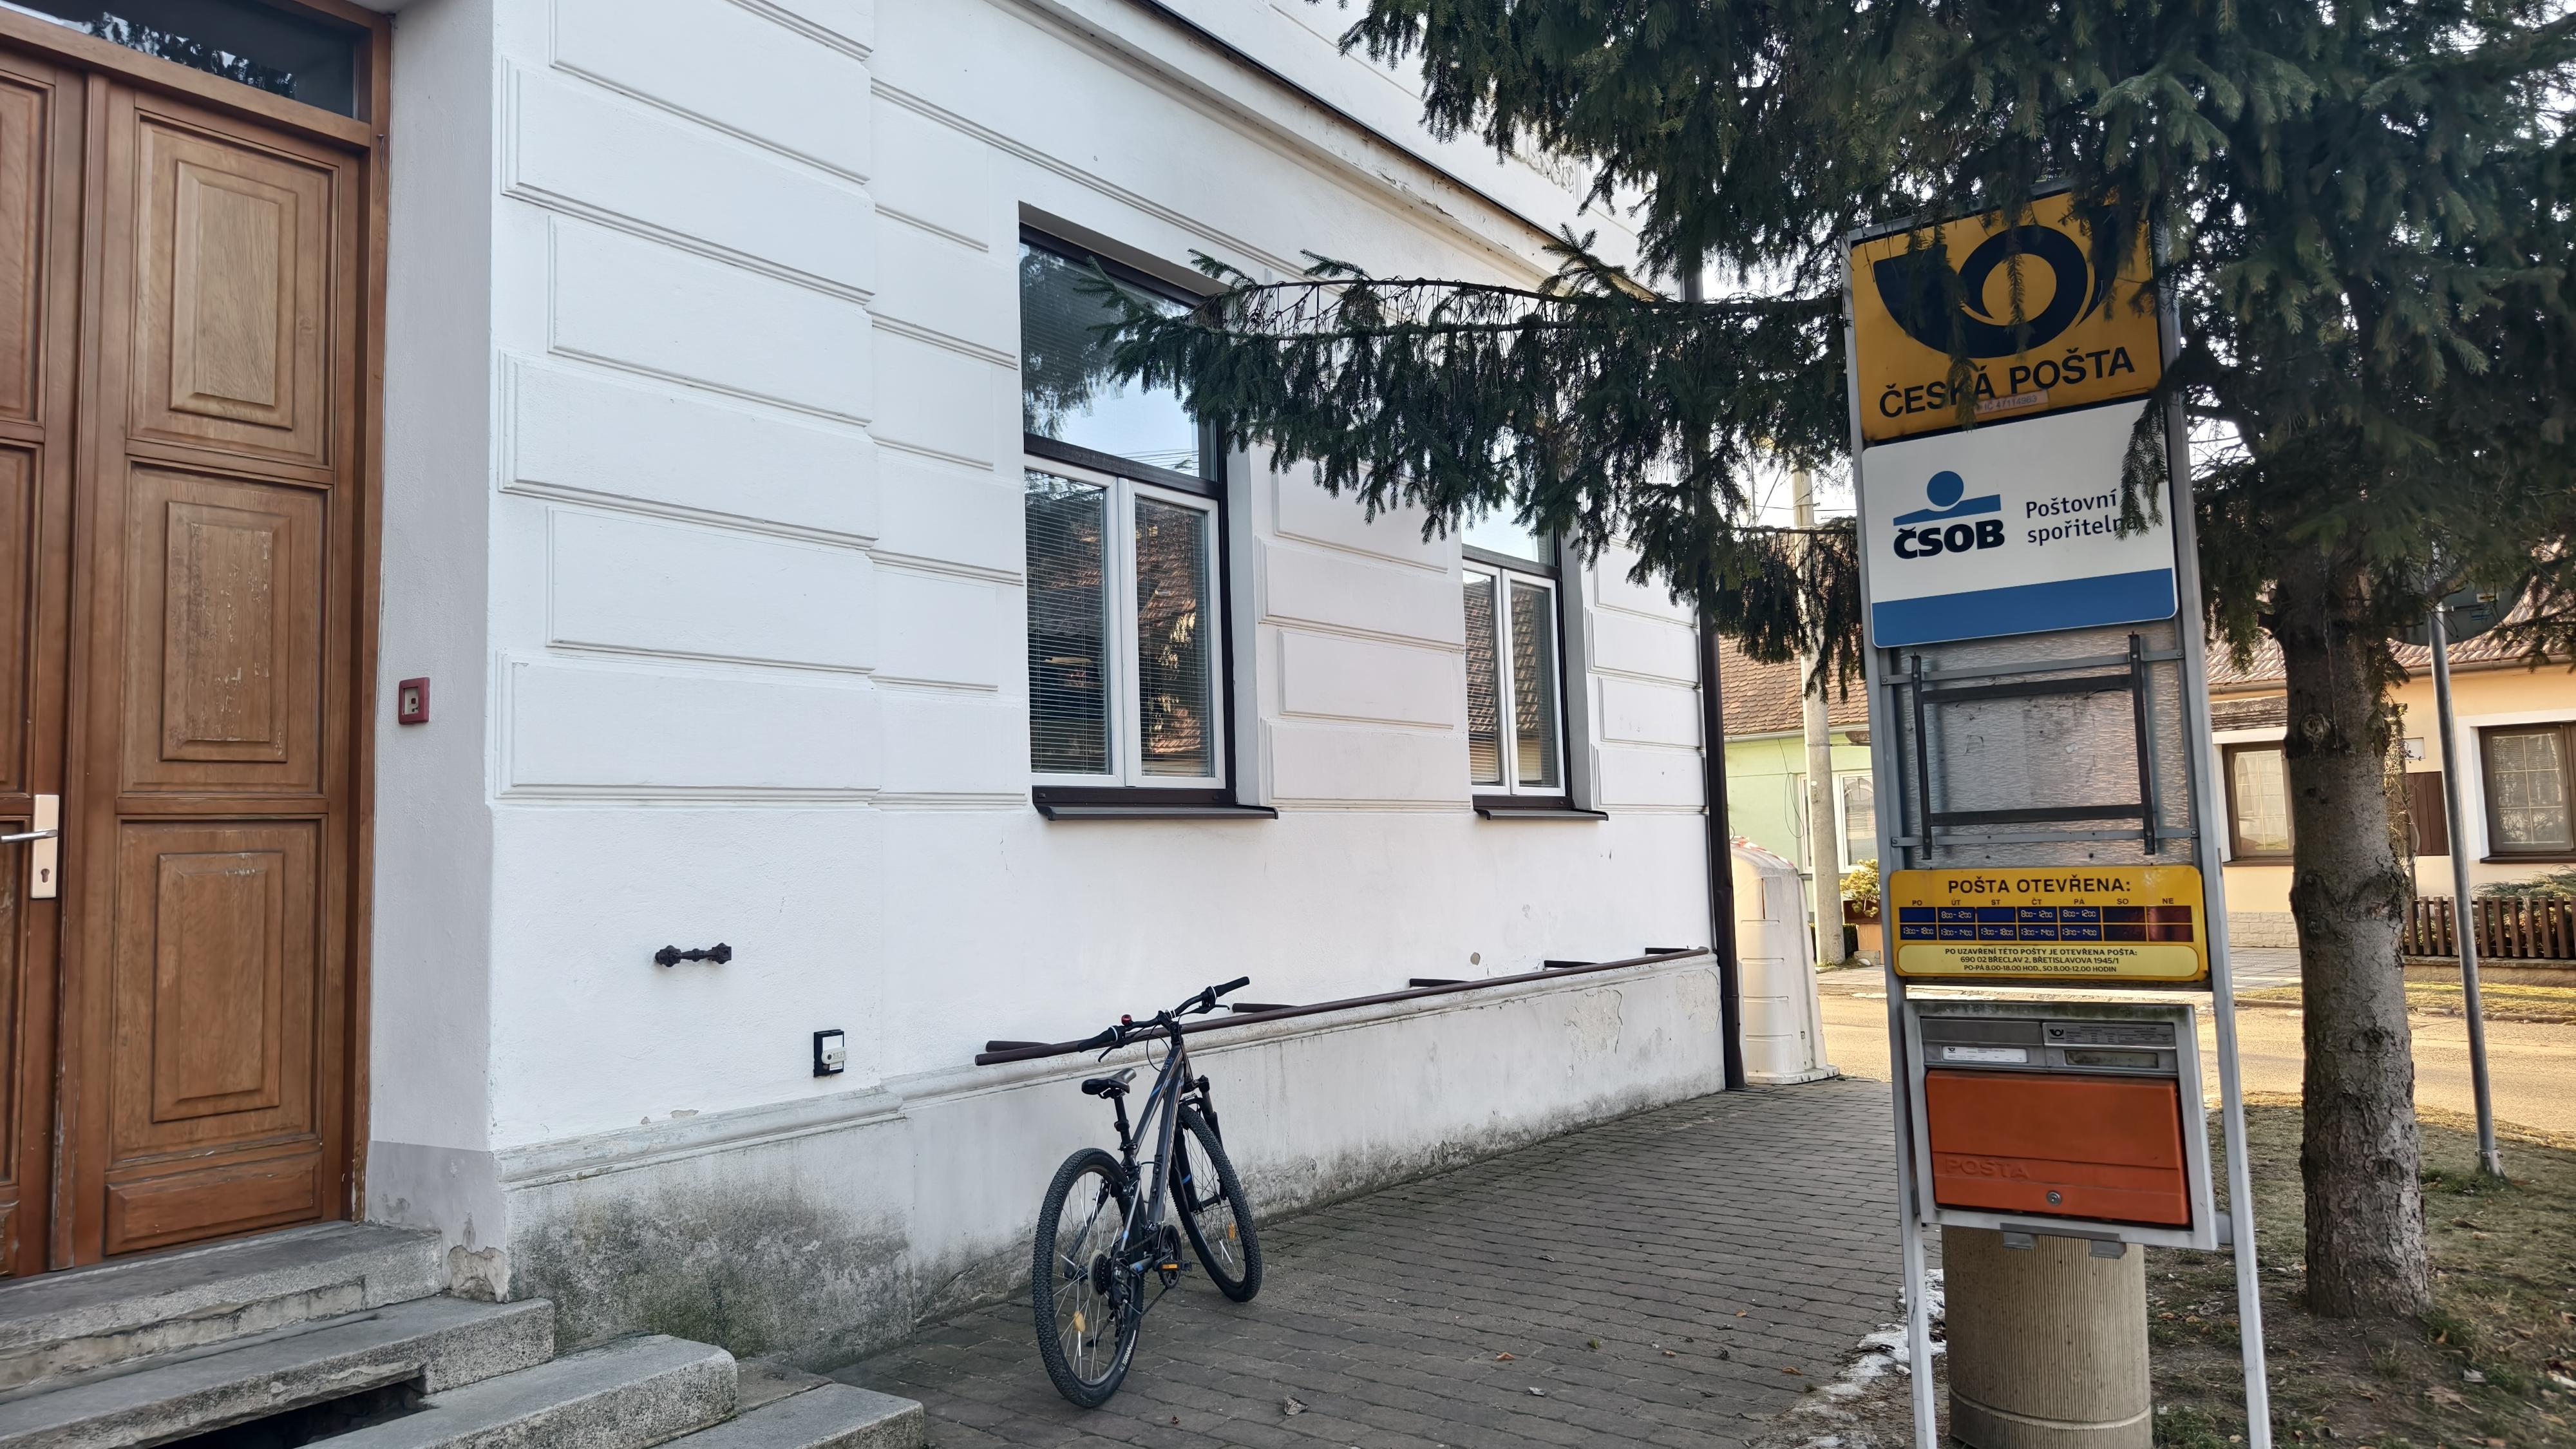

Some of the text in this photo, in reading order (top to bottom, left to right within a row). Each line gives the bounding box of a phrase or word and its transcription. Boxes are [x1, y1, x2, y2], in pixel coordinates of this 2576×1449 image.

[2009, 346, 2135, 395] POŠTA
[2026, 488, 2117, 518] Poštovní
[1893, 519, 2005, 559] ČSOB
[1948, 874, 2131, 893] POŠTA OTEVŘENA:
